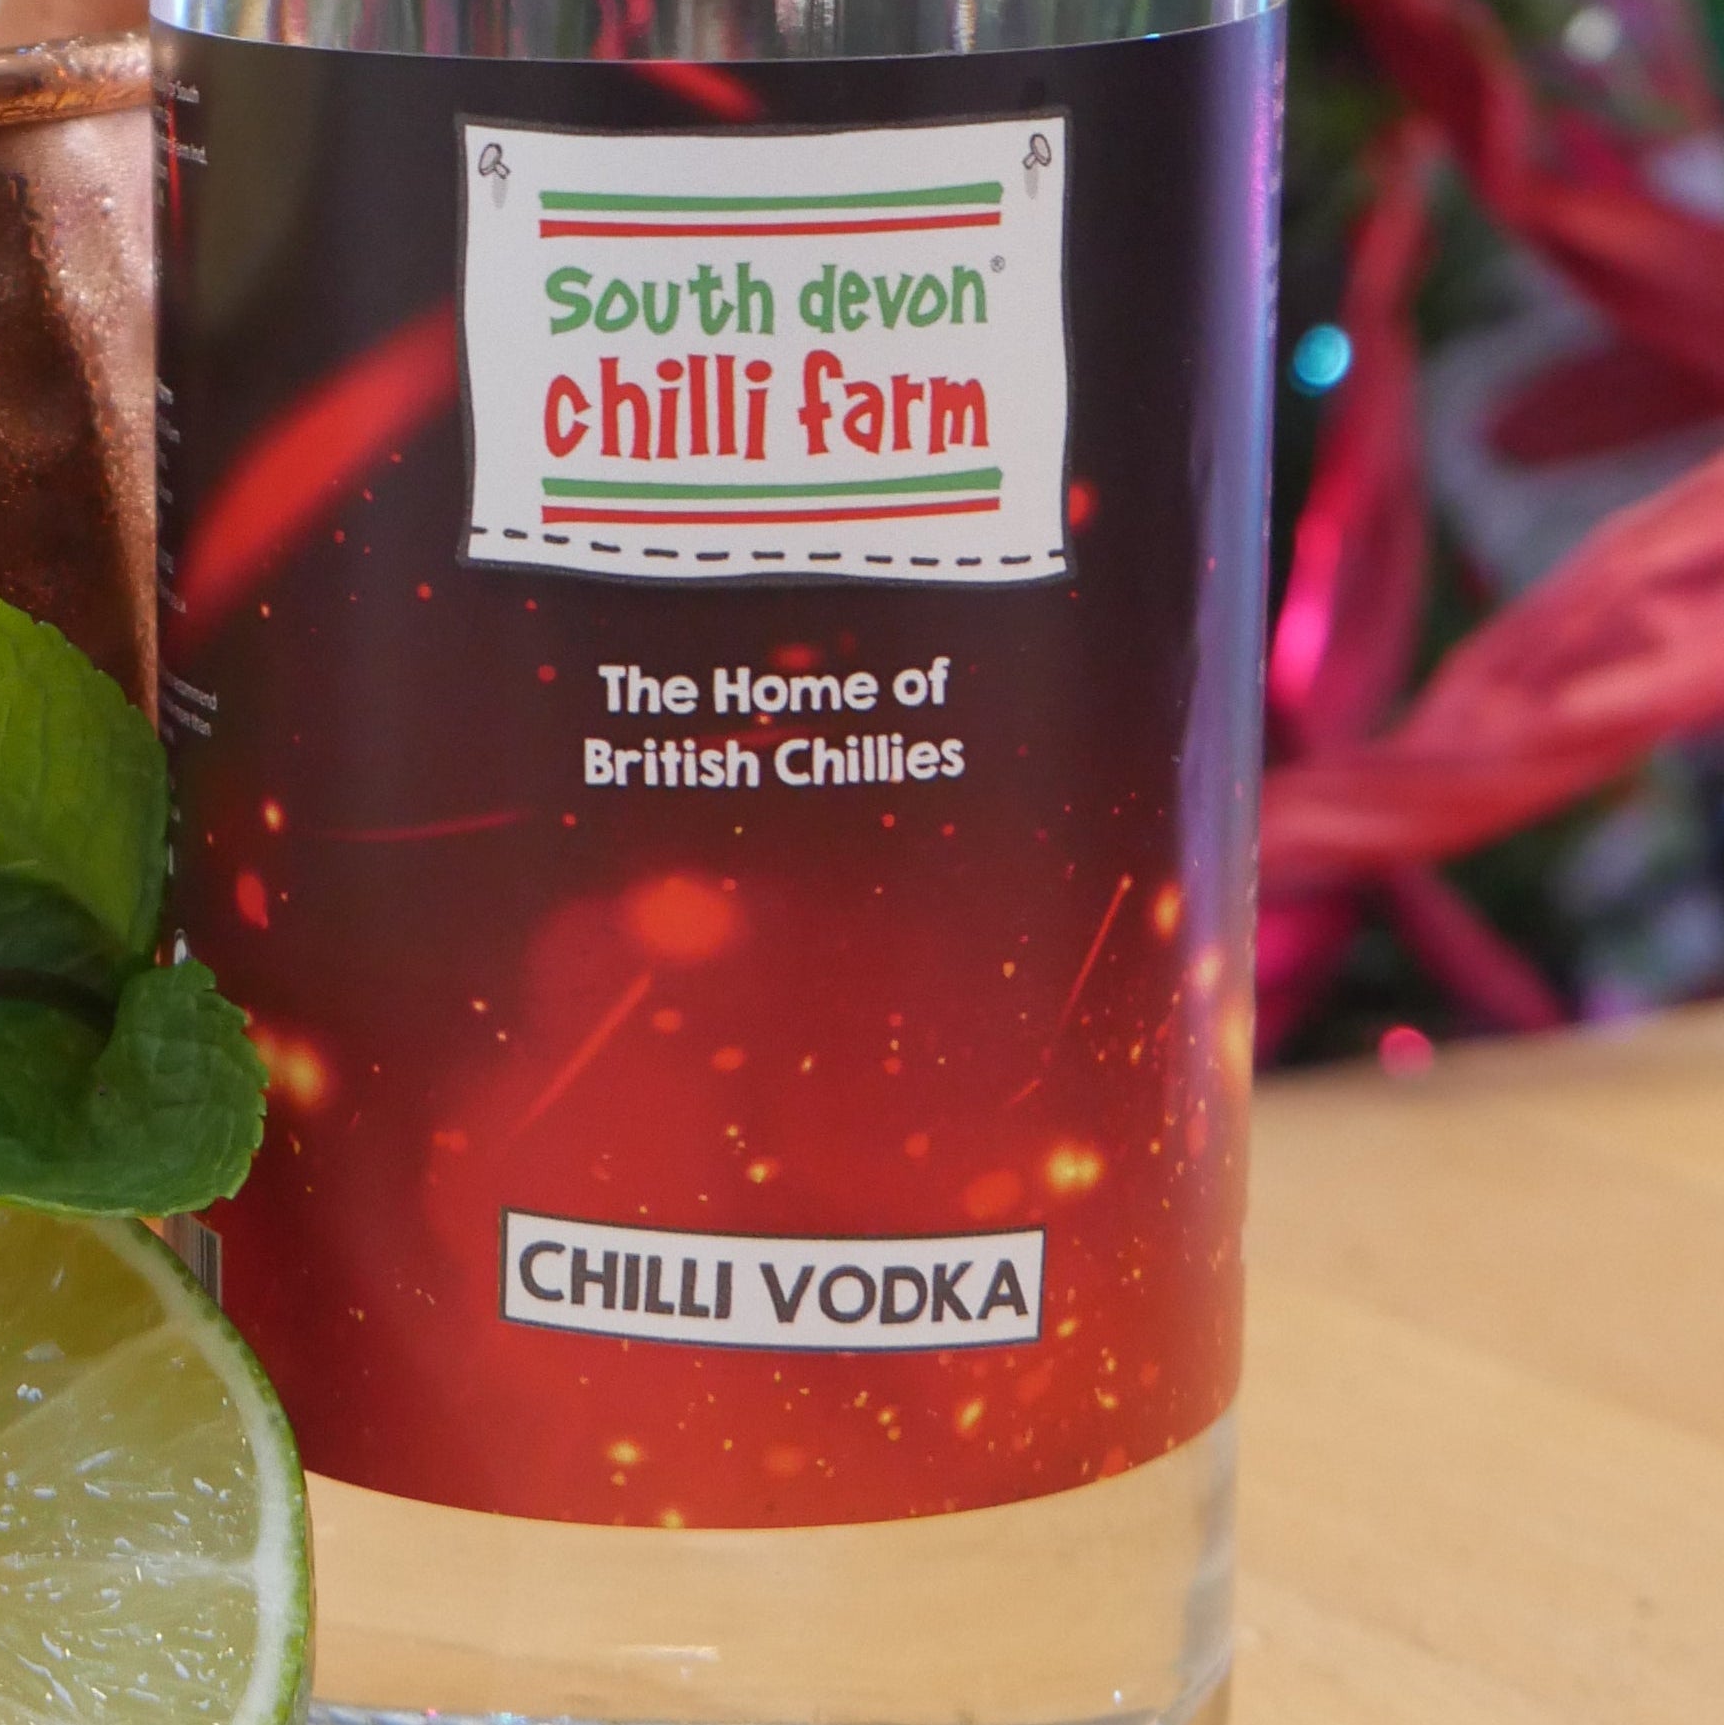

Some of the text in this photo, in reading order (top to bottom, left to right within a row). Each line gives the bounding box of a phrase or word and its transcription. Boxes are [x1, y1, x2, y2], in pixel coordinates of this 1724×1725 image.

[544, 349, 989, 461] chilli farm
[598, 656, 951, 715] The Home of
[584, 734, 965, 788] British Chillies
[518, 1240, 1029, 1324] CHILLI VODKA
